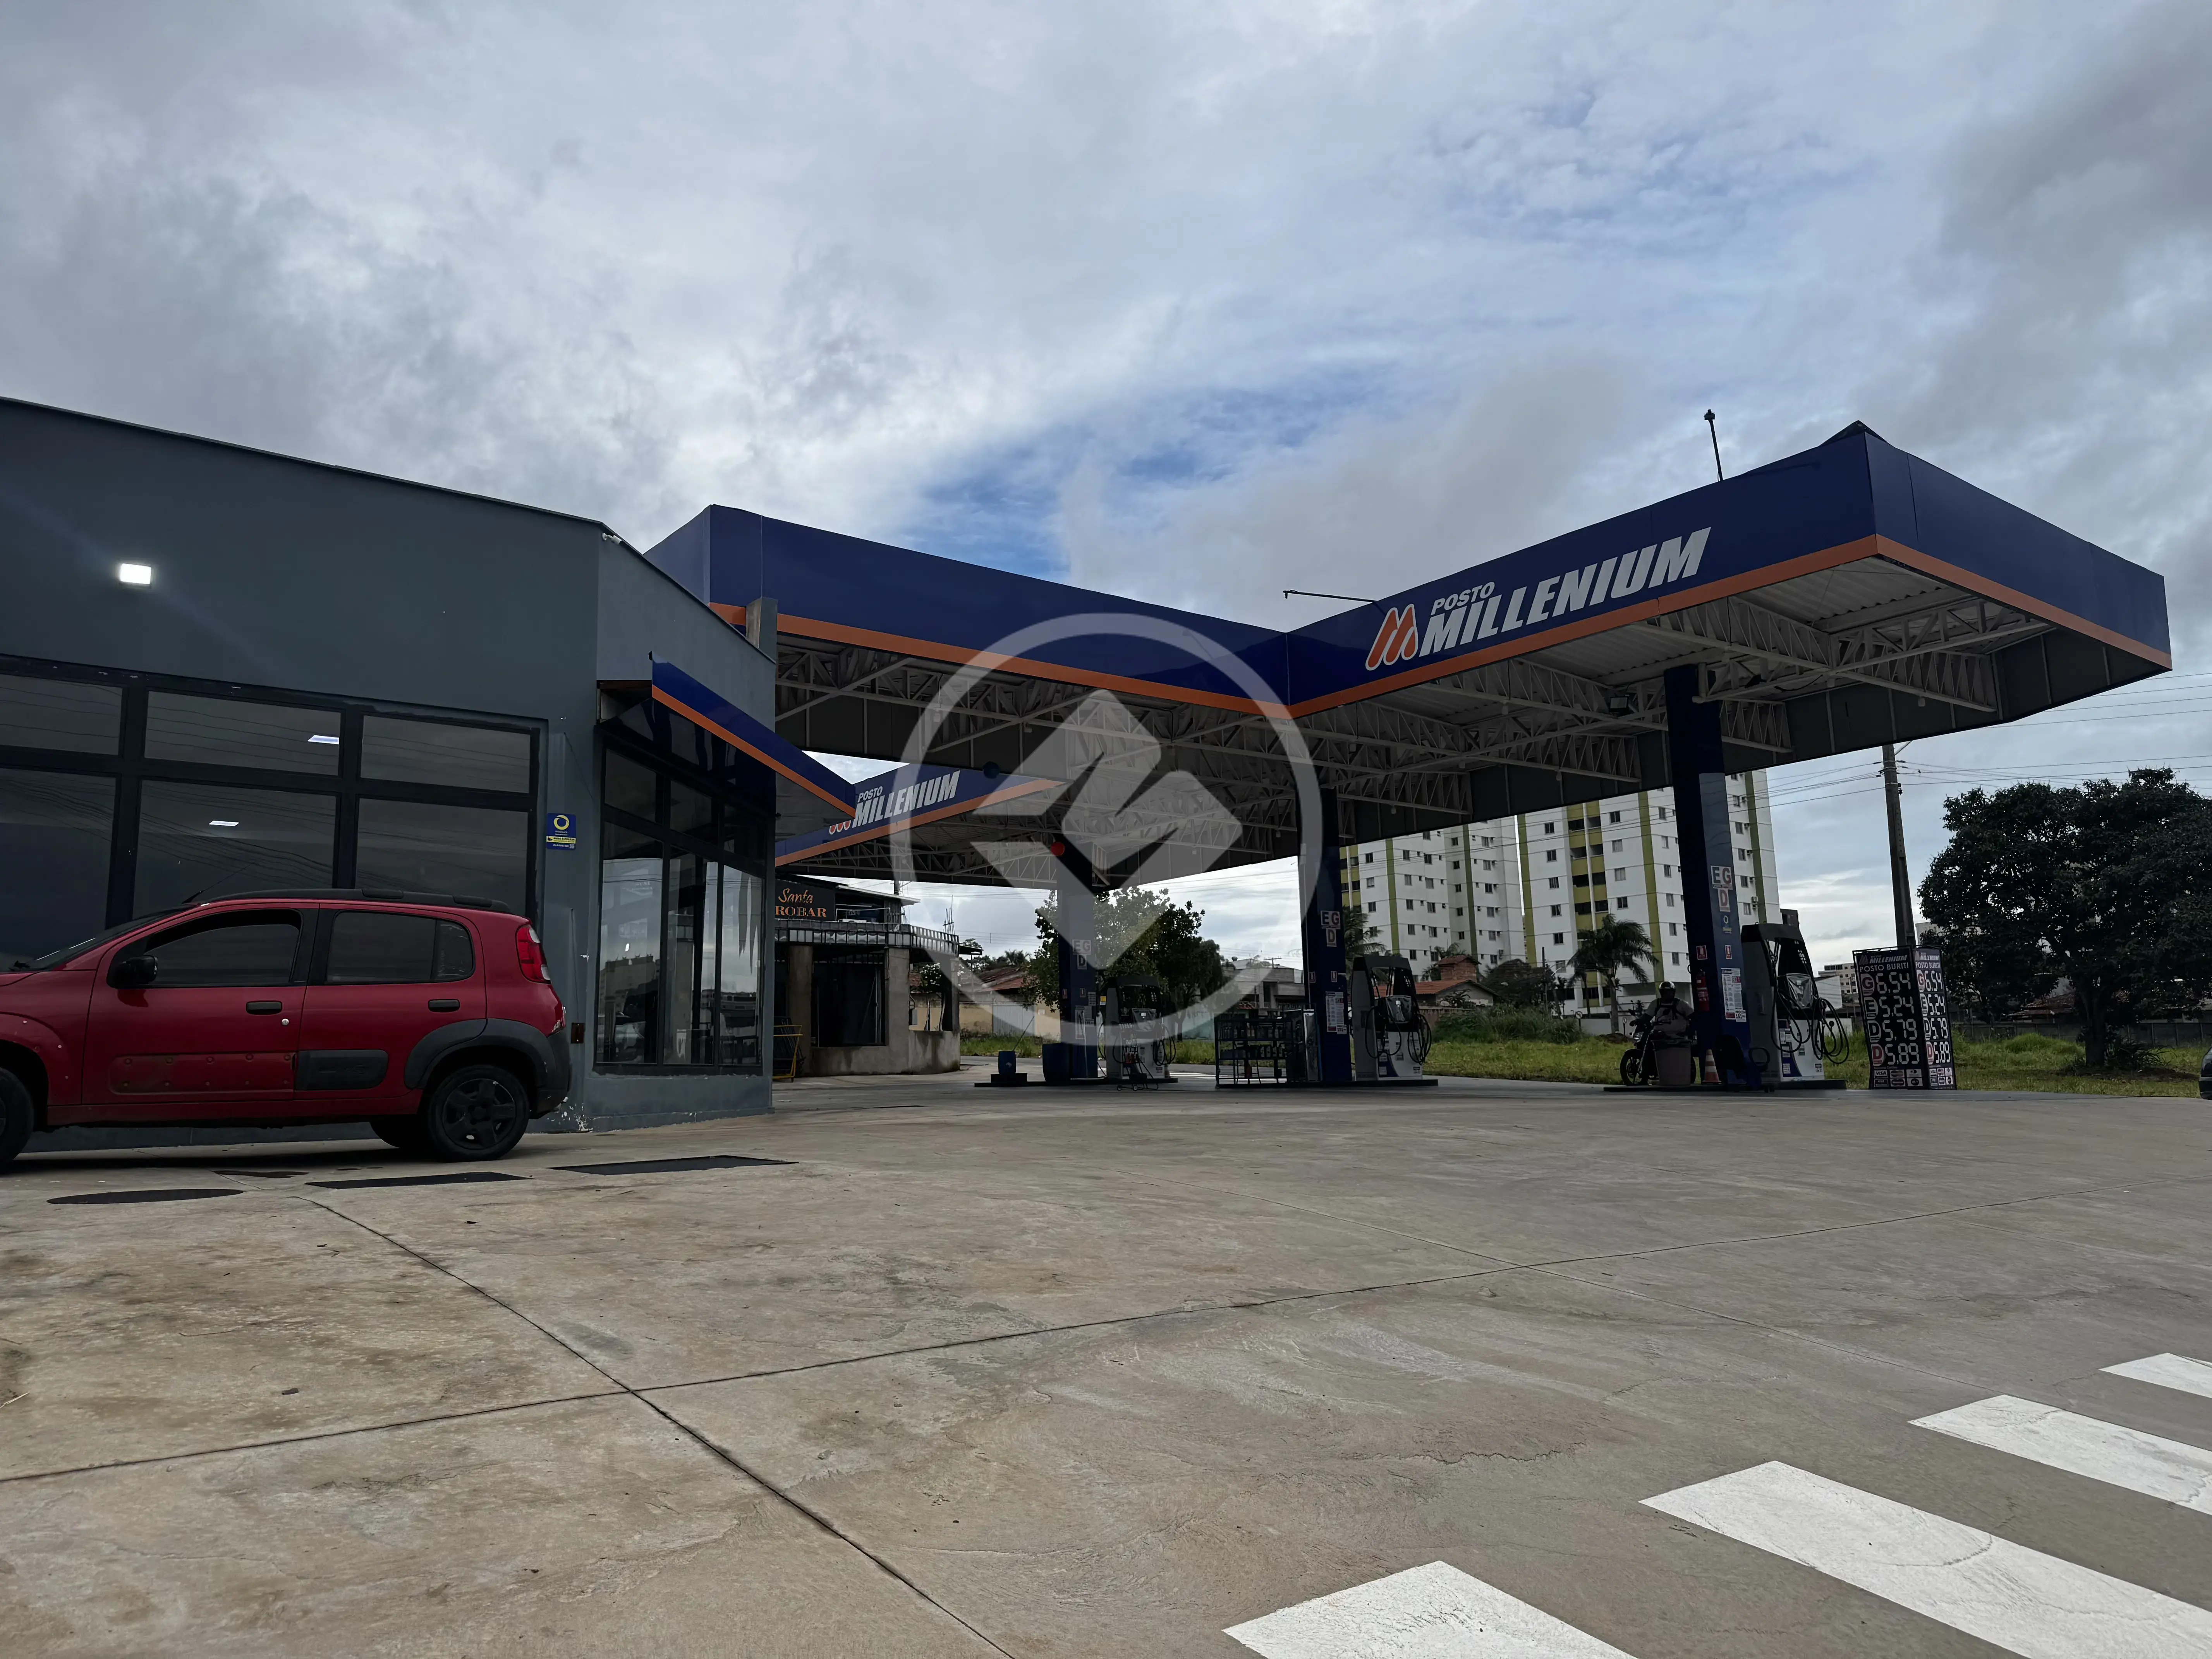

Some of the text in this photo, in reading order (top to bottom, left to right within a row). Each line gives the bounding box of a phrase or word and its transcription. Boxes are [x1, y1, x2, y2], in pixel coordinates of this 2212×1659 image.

[1419, 527, 1711, 657] MILLENIUM
[1431, 582, 1495, 615] POSTO
[852, 770, 960, 828] MILLENIUM
[858, 786, 883, 803] POSTO
[778, 888, 813, 903] Santa
[1720, 890, 1728, 907] D
[1869, 955, 1907, 963] MILLENIUM
[1862, 972, 1911, 993] G 6,54
[1918, 970, 1942, 991] G 6,54
[1865, 996, 1914, 1017] E 5,24
[1921, 994, 1946, 1015] E 5,24
[1869, 1018, 1917, 1041] D 5,79
[1924, 1018, 1948, 1039] D 5,79
[1872, 1043, 1920, 1065] D 5,89
[1927, 1041, 1950, 1063] D 5,89
